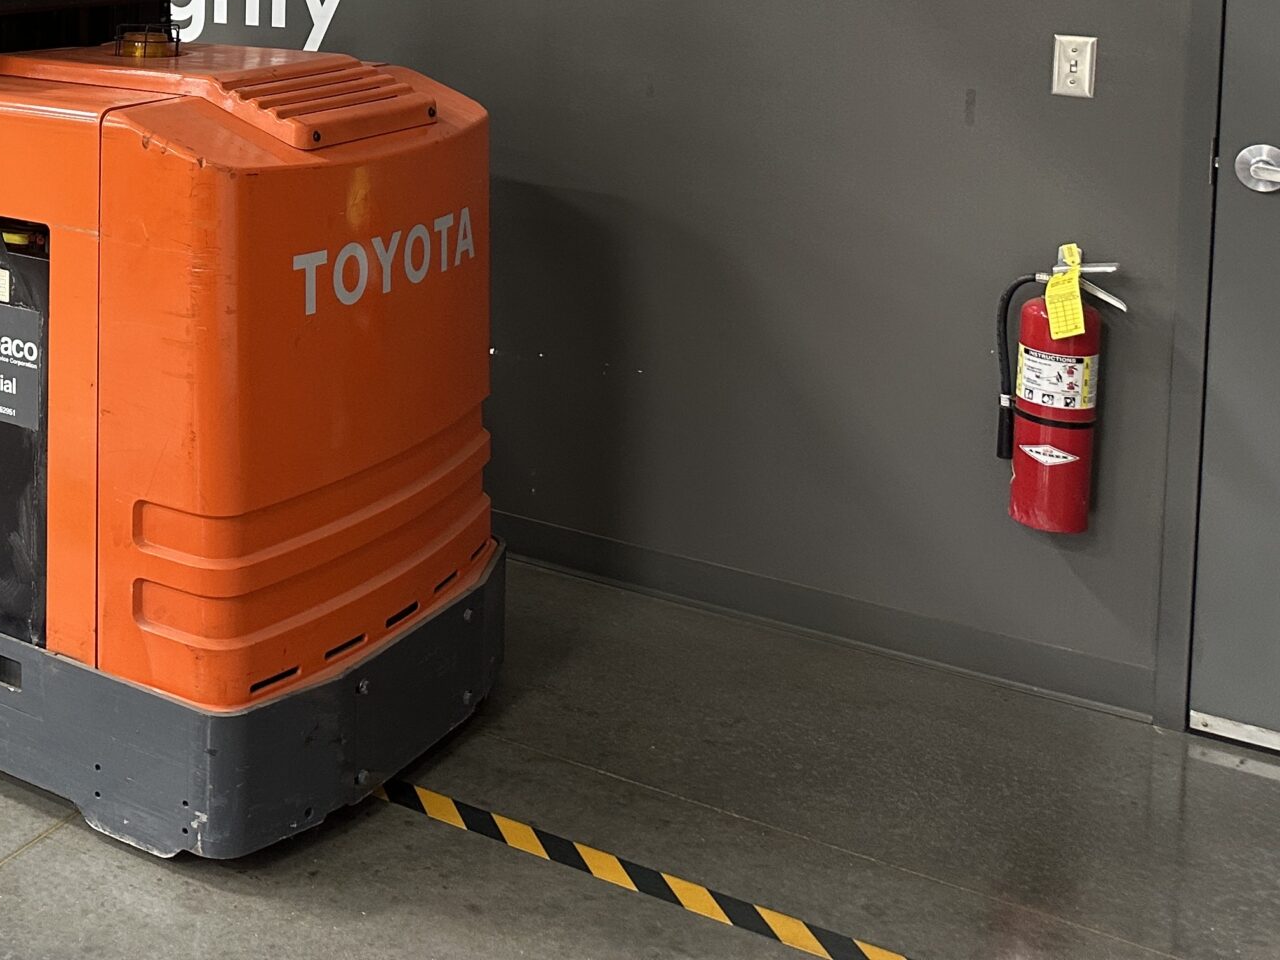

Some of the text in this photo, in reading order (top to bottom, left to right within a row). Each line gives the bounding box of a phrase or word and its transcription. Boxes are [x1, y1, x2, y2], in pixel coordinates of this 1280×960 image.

[292, 206, 475, 316] TOYOTA
[10, 357, 38, 370] Corporation
[1028, 349, 1077, 364] INSTRUCTIONS
